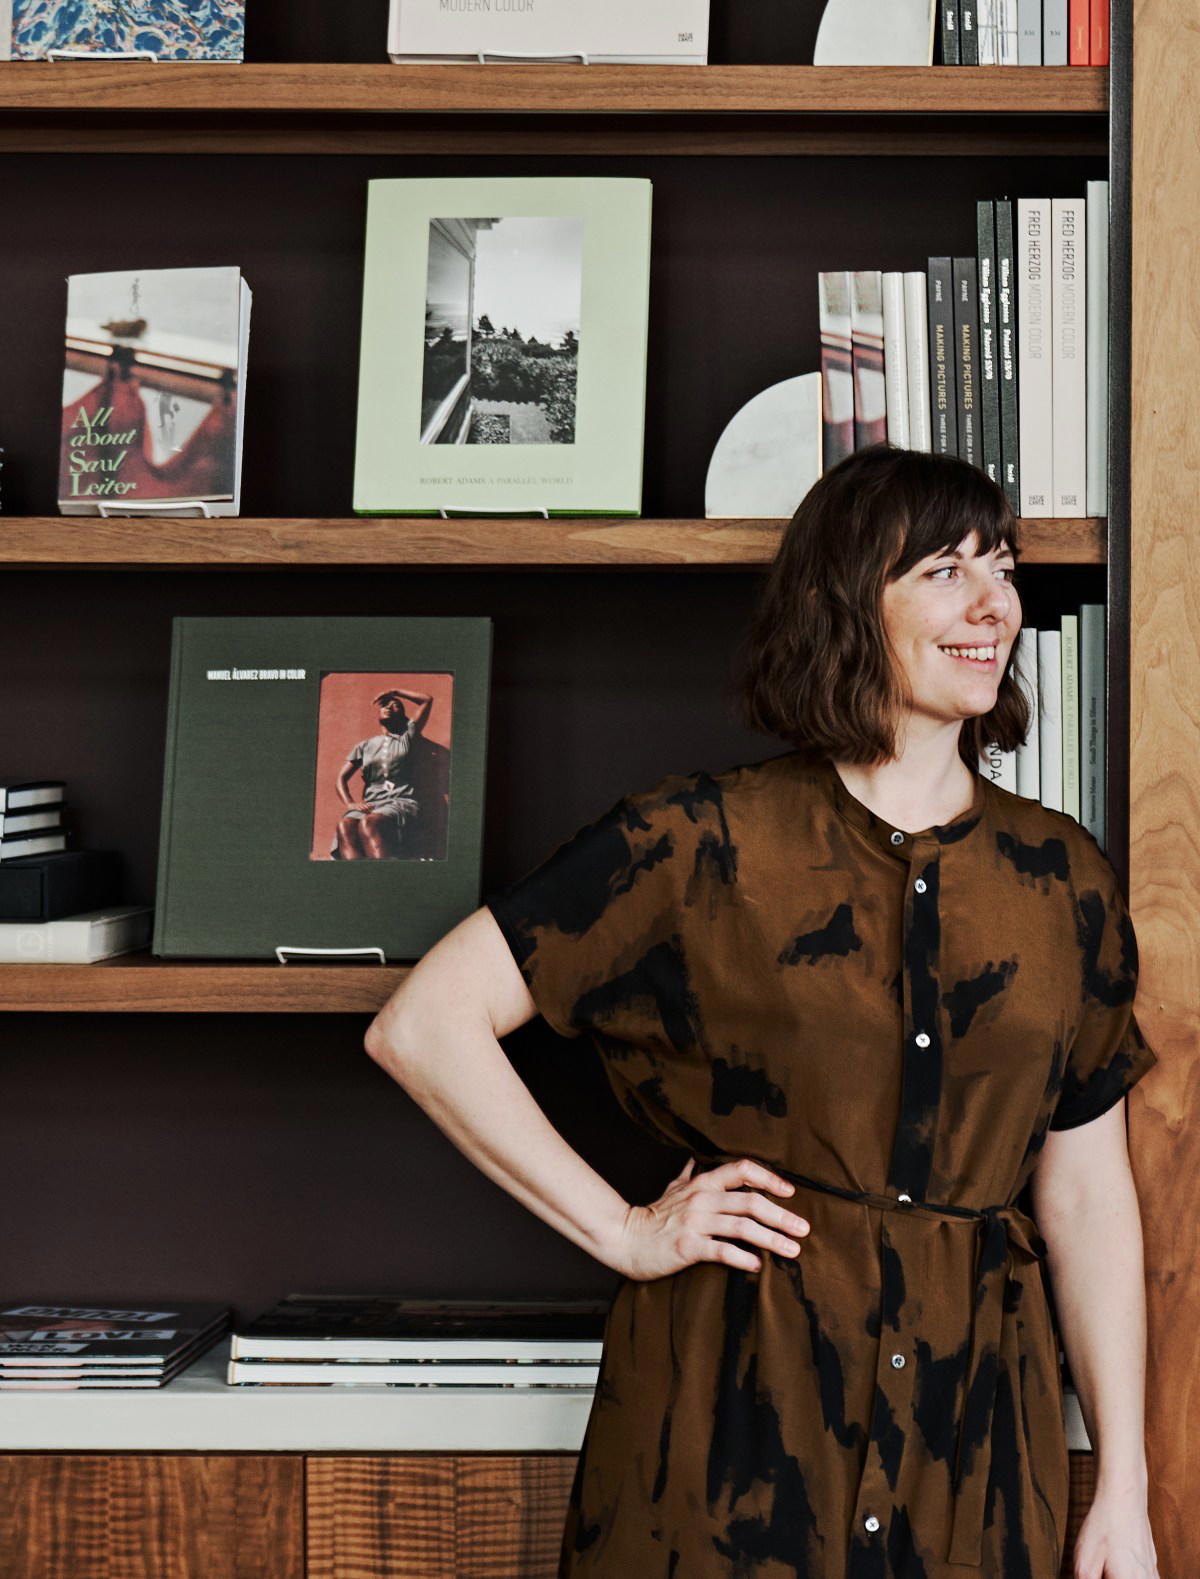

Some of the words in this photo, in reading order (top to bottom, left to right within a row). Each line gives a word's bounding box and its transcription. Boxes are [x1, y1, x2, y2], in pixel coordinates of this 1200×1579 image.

[1028, 209, 1041, 236] FRED
[1062, 209, 1075, 236] FRED
[982, 258, 990, 287] William
[1002, 258, 1010, 287] William
[1028, 239, 1041, 281] HERZOG
[1062, 239, 1075, 281] HERZOG
[980, 288, 991, 323] Eggleston
[1000, 288, 1010, 323] Eggleston
[1028, 283, 1041, 325] MODERN
[1062, 283, 1075, 325] MODERN
[935, 324, 945, 361] MAKING
[962, 324, 972, 361] MAKING
[1028, 327, 1041, 360] COLOR
[1062, 327, 1075, 360] COLOR
[937, 363, 948, 410] PICTURES
[964, 363, 975, 410] PICTURES
[70, 406, 114, 429] All
[69, 429, 137, 447] about
[69, 449, 128, 473] Saul
[69, 472, 138, 496] Leiter
[1066, 636, 1074, 669] ROBERT
[207, 670, 231, 681] MANUEL
[258, 669, 279, 680] BRAVO
[279, 669, 286, 680] IN
[286, 668, 306, 680] COLOR
[1066, 673, 1074, 703] ADAMS
[1066, 713, 1075, 755] PARALLEL
[989, 745, 1002, 780] NDA
[1067, 757, 1075, 789] WORLD
[43, 1330, 165, 1340] LOVE
